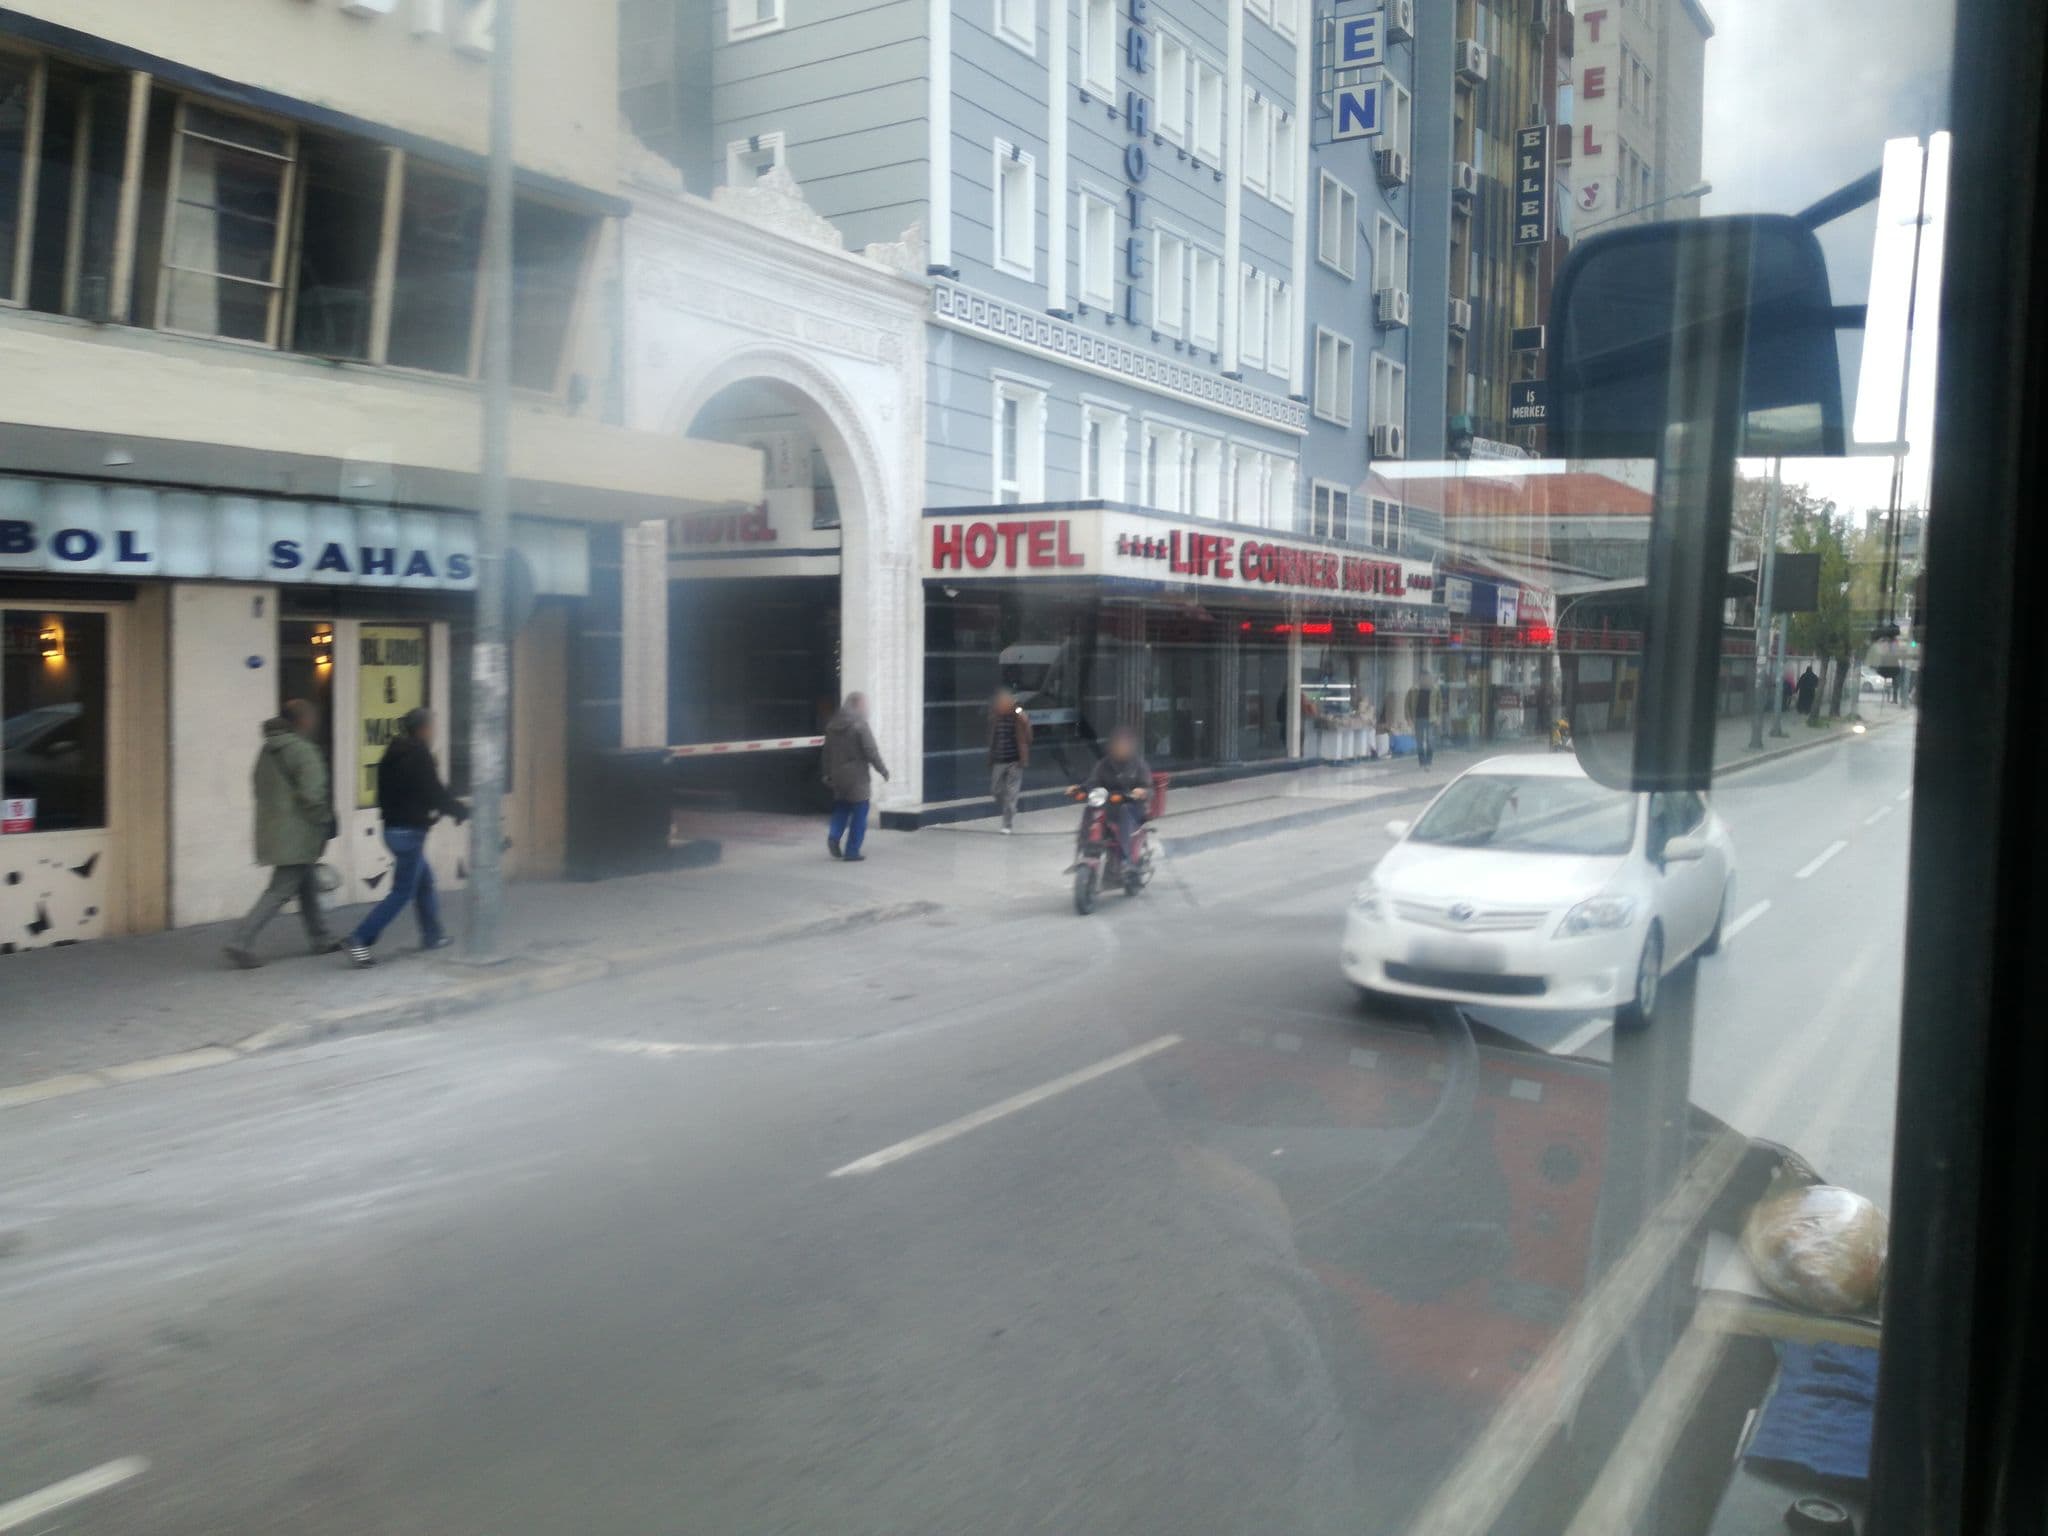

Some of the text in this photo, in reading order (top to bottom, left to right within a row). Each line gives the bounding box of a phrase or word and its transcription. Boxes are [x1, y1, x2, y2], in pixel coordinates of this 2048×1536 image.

[1338, 18, 1376, 133] EN
[1583, 9, 1607, 156] TEL
[1124, 91, 1148, 325] HOTEL
[1520, 131, 1541, 239] ELLER
[0, 519, 153, 562] BOL
[932, 520, 1085, 570] HOTEL
[1169, 529, 1406, 597] LIFE CORNER HOTEL
